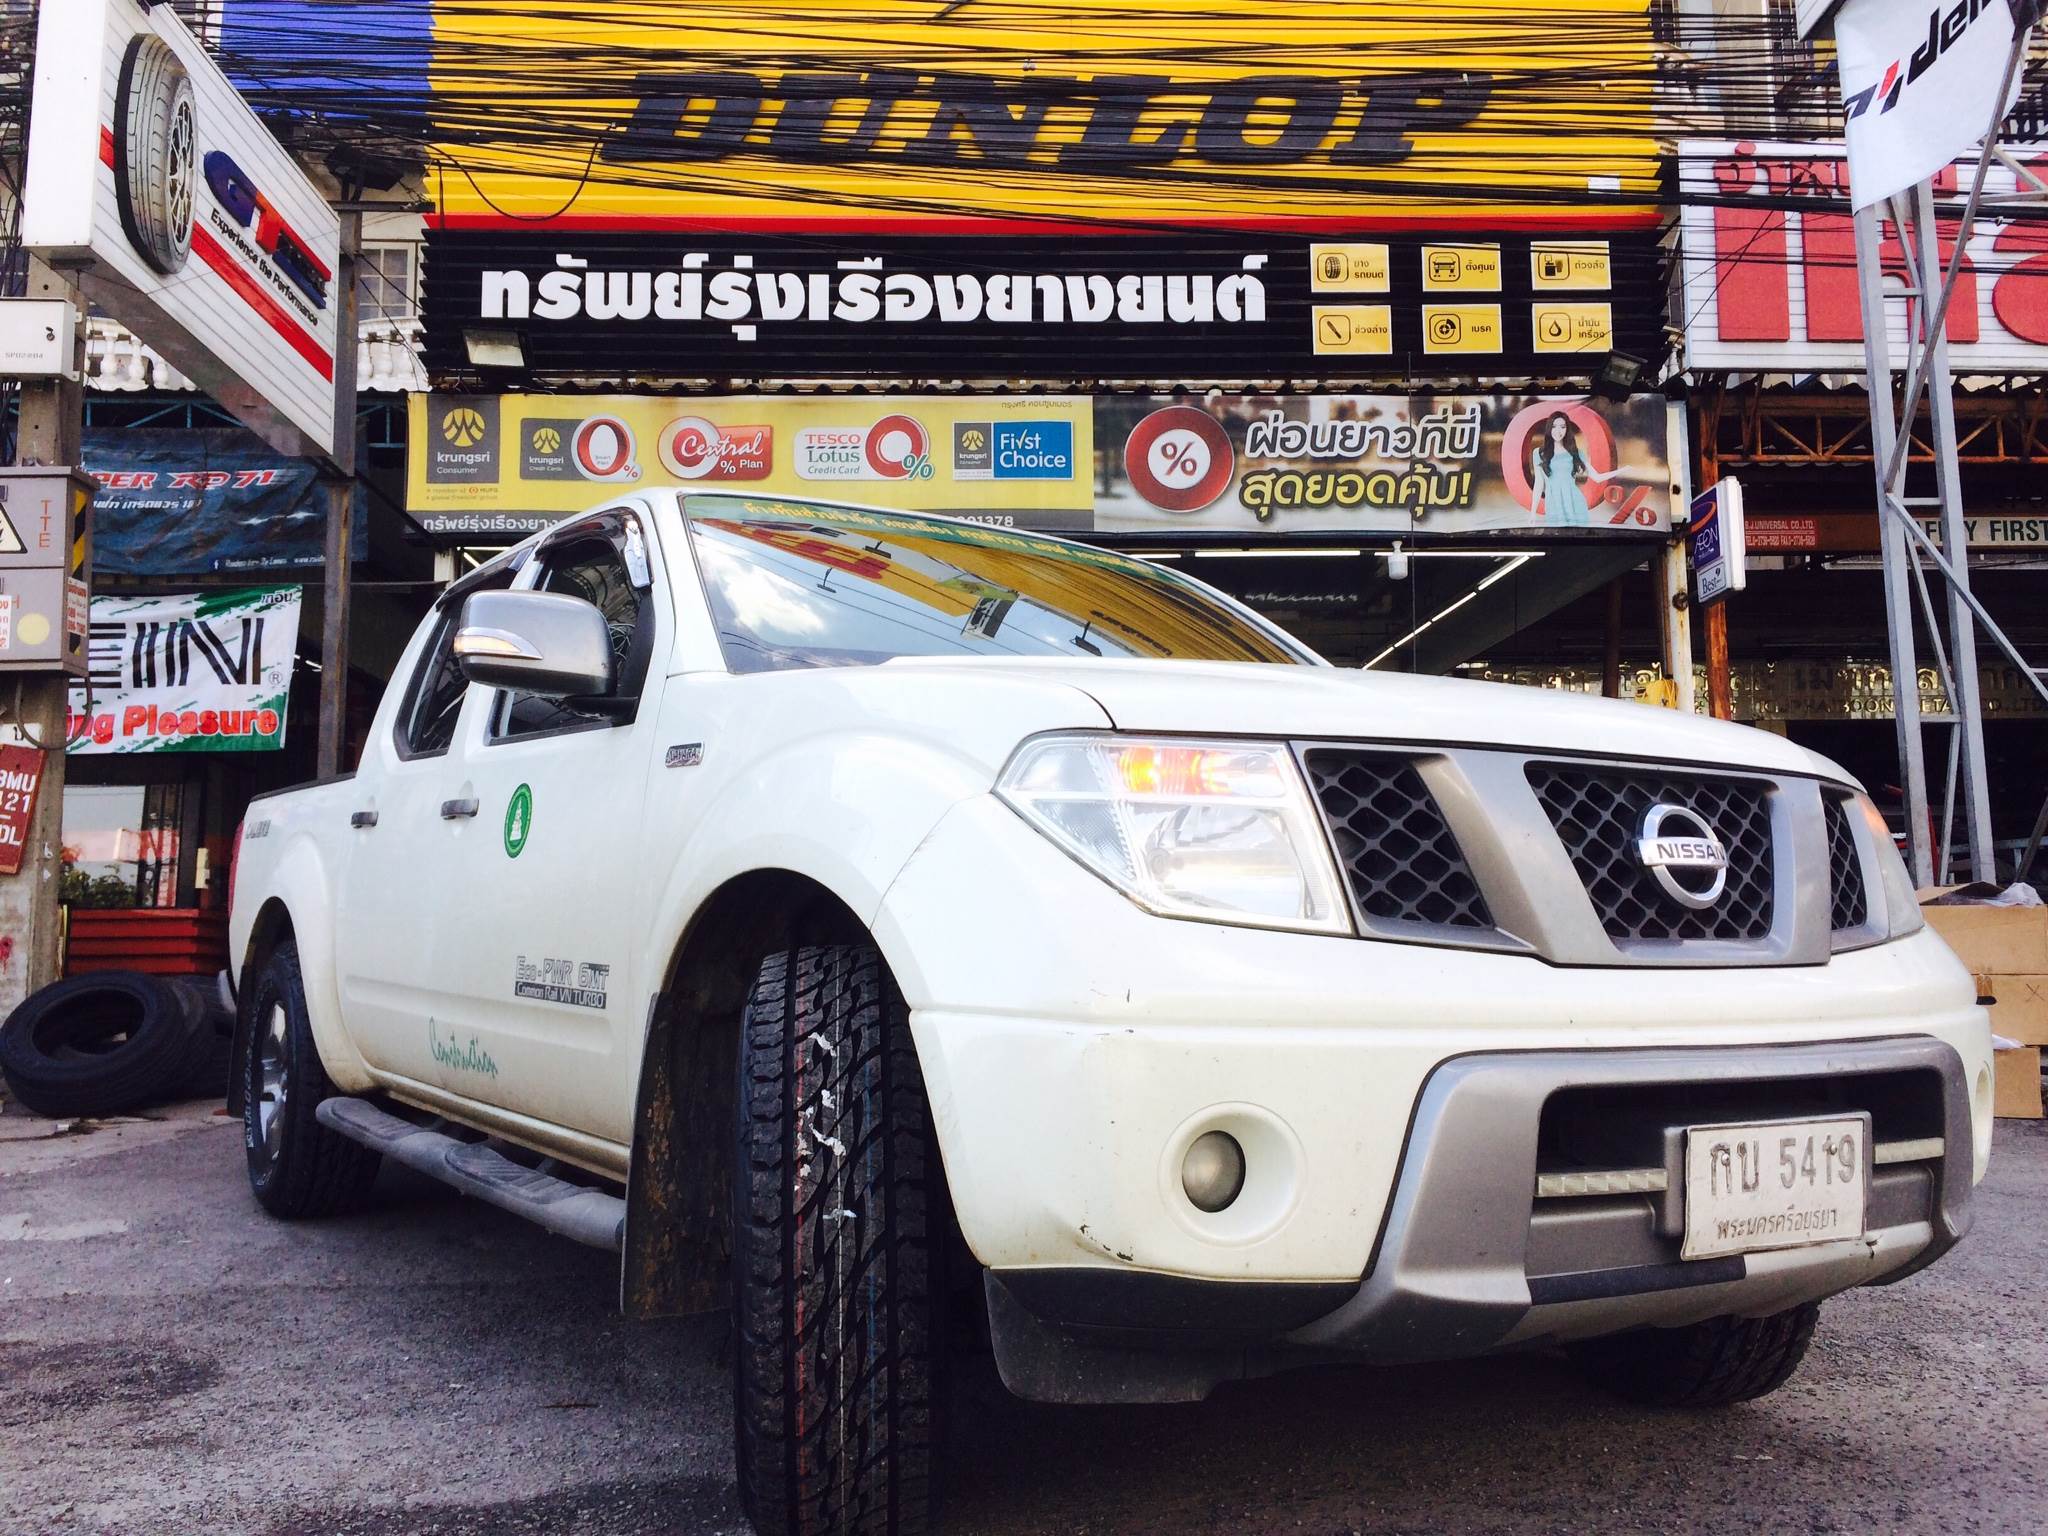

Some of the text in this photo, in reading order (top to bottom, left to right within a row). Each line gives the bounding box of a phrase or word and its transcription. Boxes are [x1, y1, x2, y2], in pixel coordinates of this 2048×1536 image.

[601, 72, 1492, 164] DUNLOP
[210, 208, 258, 264] Experience
[258, 257, 272, 280] the
[272, 271, 318, 327] Performance
[481, 252, 1267, 341] ทรัพย์รุ่งเรืองยางยนต์
[804, 433, 861, 445] TESCO
[1249, 407, 1478, 456] ผ่อนยาวที่นี่
[680, 431, 763, 457] Central
[437, 451, 490, 464] krungsri
[529, 456, 564, 466] krungsri
[740, 459, 763, 469] Plan
[807, 450, 861, 463] Lotus
[999, 451, 1067, 468] Choice
[436, 466, 478, 475] Consumer
[807, 465, 860, 475] Credit Card
[1243, 465, 1472, 518] สุดยอดคุ้ม!
[122, 703, 279, 738] Pleasure
[1656, 842, 1726, 862] NISSAN
[574, 991, 605, 1008] TURBO
[1779, 1133, 1856, 1190] 5419
